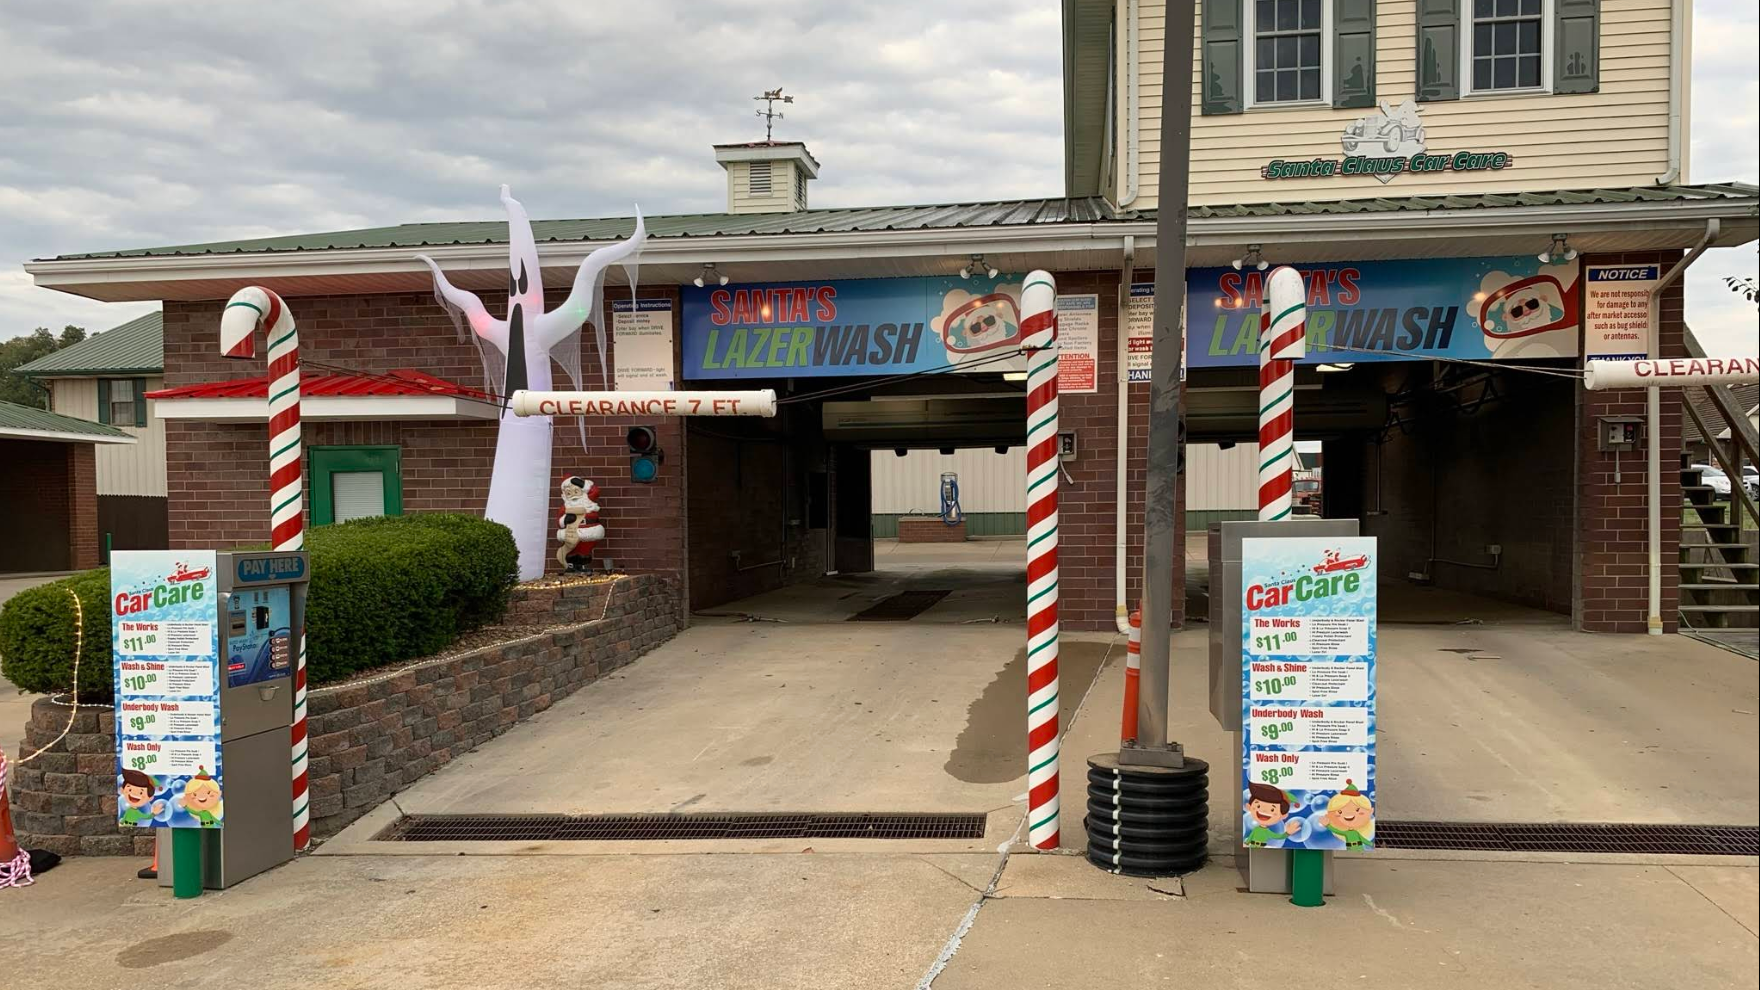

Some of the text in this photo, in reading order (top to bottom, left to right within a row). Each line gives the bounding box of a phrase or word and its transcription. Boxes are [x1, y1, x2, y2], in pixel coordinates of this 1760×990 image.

[1267, 151, 1508, 179] Santa Claus Car Care
[1598, 269, 1648, 280] NOTICE
[1219, 268, 1360, 310] SAA'S
[710, 286, 838, 326] SANTA'S
[1606, 301, 1630, 309] damage
[1208, 306, 1460, 356] LARWASH
[1617, 322, 1628, 330] bug
[539, 400, 676, 415] CLEARANCE
[688, 400, 701, 414] 7
[243, 558, 300, 576] PAY HERE
[122, 623, 159, 631] The Works
[1254, 618, 1300, 627] The Works
[121, 662, 140, 670] Wash
[1252, 663, 1275, 672] Wash
[1284, 663, 1307, 672] Shine
[123, 703, 159, 712] Underbody
[1252, 709, 1323, 719] Underbody Wash
[147, 743, 161, 752] Only
[1256, 754, 1299, 764] Wash Only
